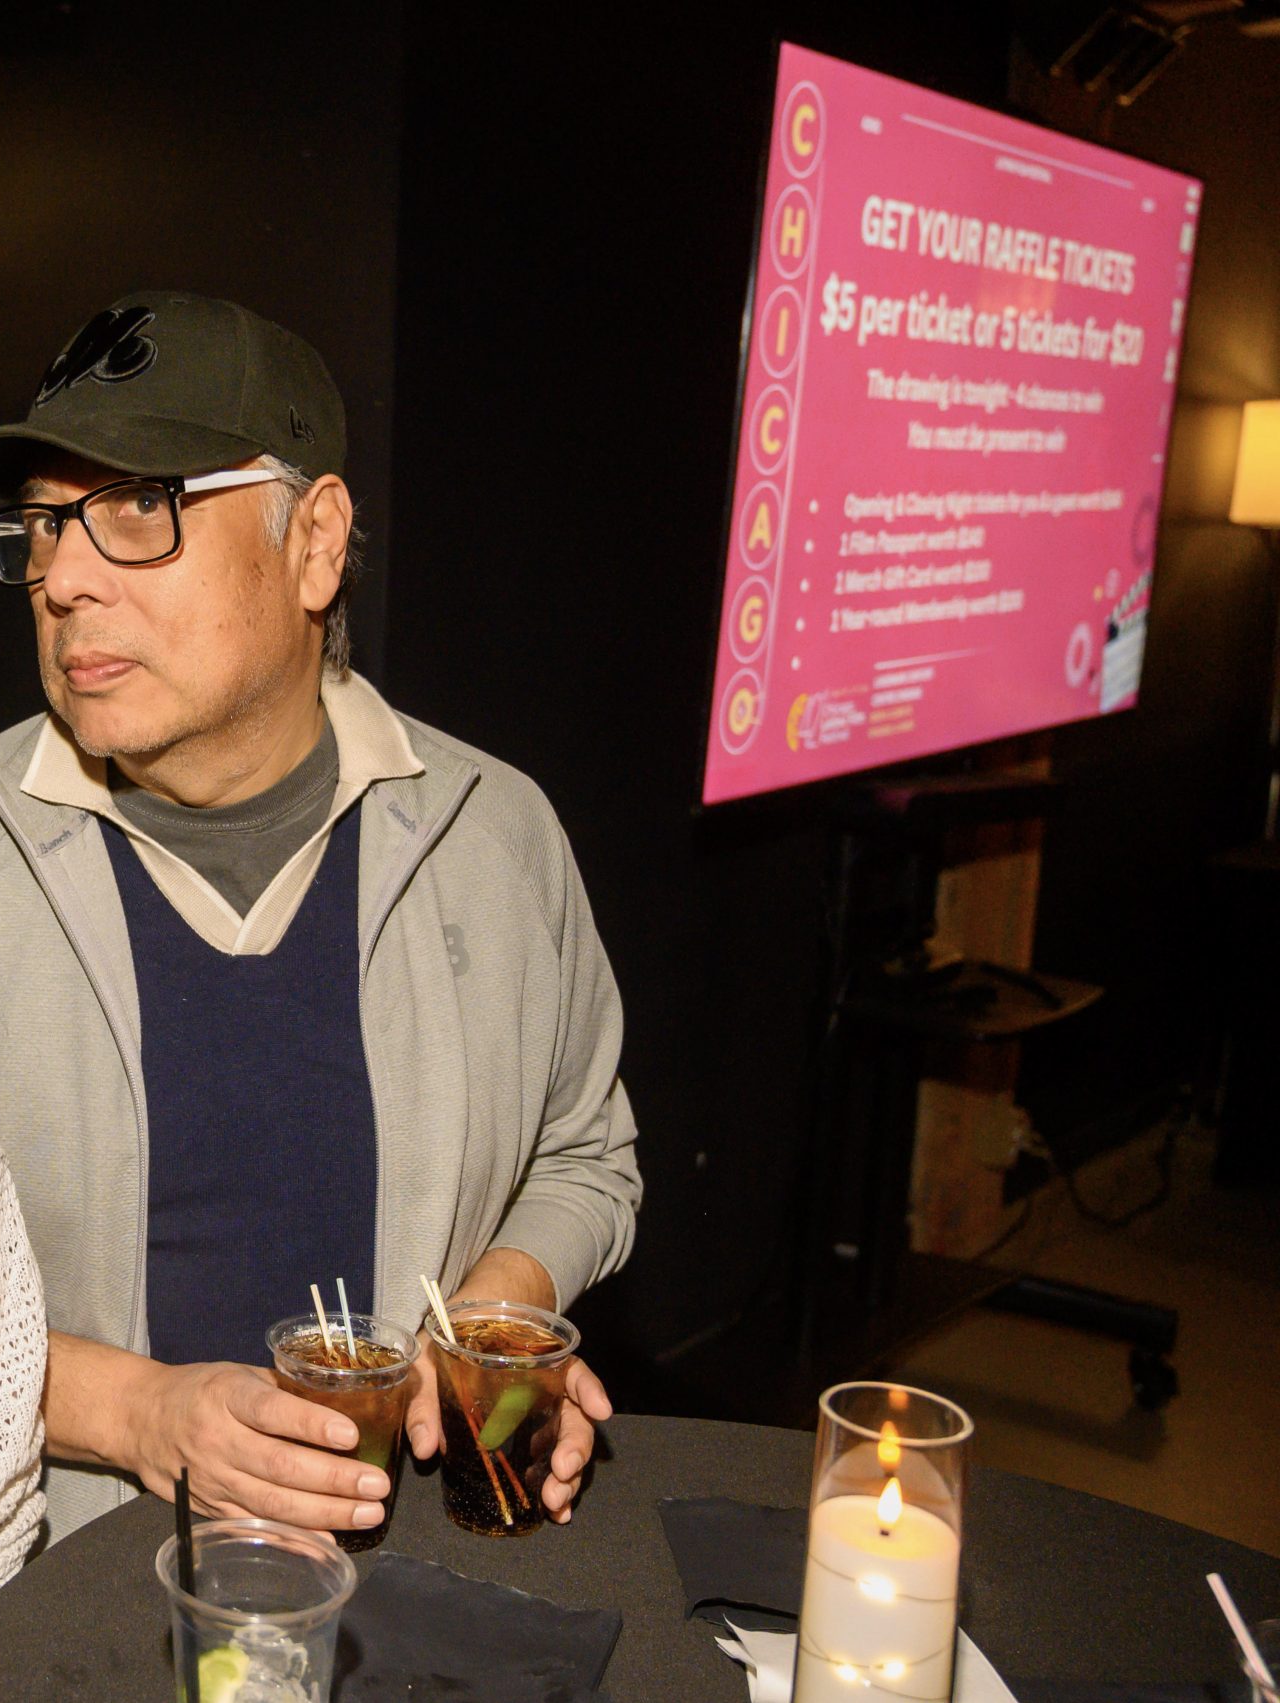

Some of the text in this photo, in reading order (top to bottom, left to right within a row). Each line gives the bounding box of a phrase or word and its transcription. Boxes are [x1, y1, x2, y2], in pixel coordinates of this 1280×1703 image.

[861, 195, 1136, 295] GET YOUR RAFFLE TICKETS
[820, 271, 1145, 367] $5 per ticket or 5 tickets for $20
[867, 368, 894, 400] The
[896, 370, 949, 411] drawing
[951, 374, 961, 404] is
[963, 377, 1009, 413] tonight
[728, 105, 815, 735] CHICAGO
[907, 419, 931, 449] You
[934, 425, 966, 450] must
[968, 422, 984, 451] be
[983, 428, 1029, 458] present
[844, 492, 895, 523] Opening
[905, 491, 945, 521] Closing
[849, 529, 875, 556] Film
[387, 801, 417, 833] Bench
[39, 830, 73, 855] Bench
